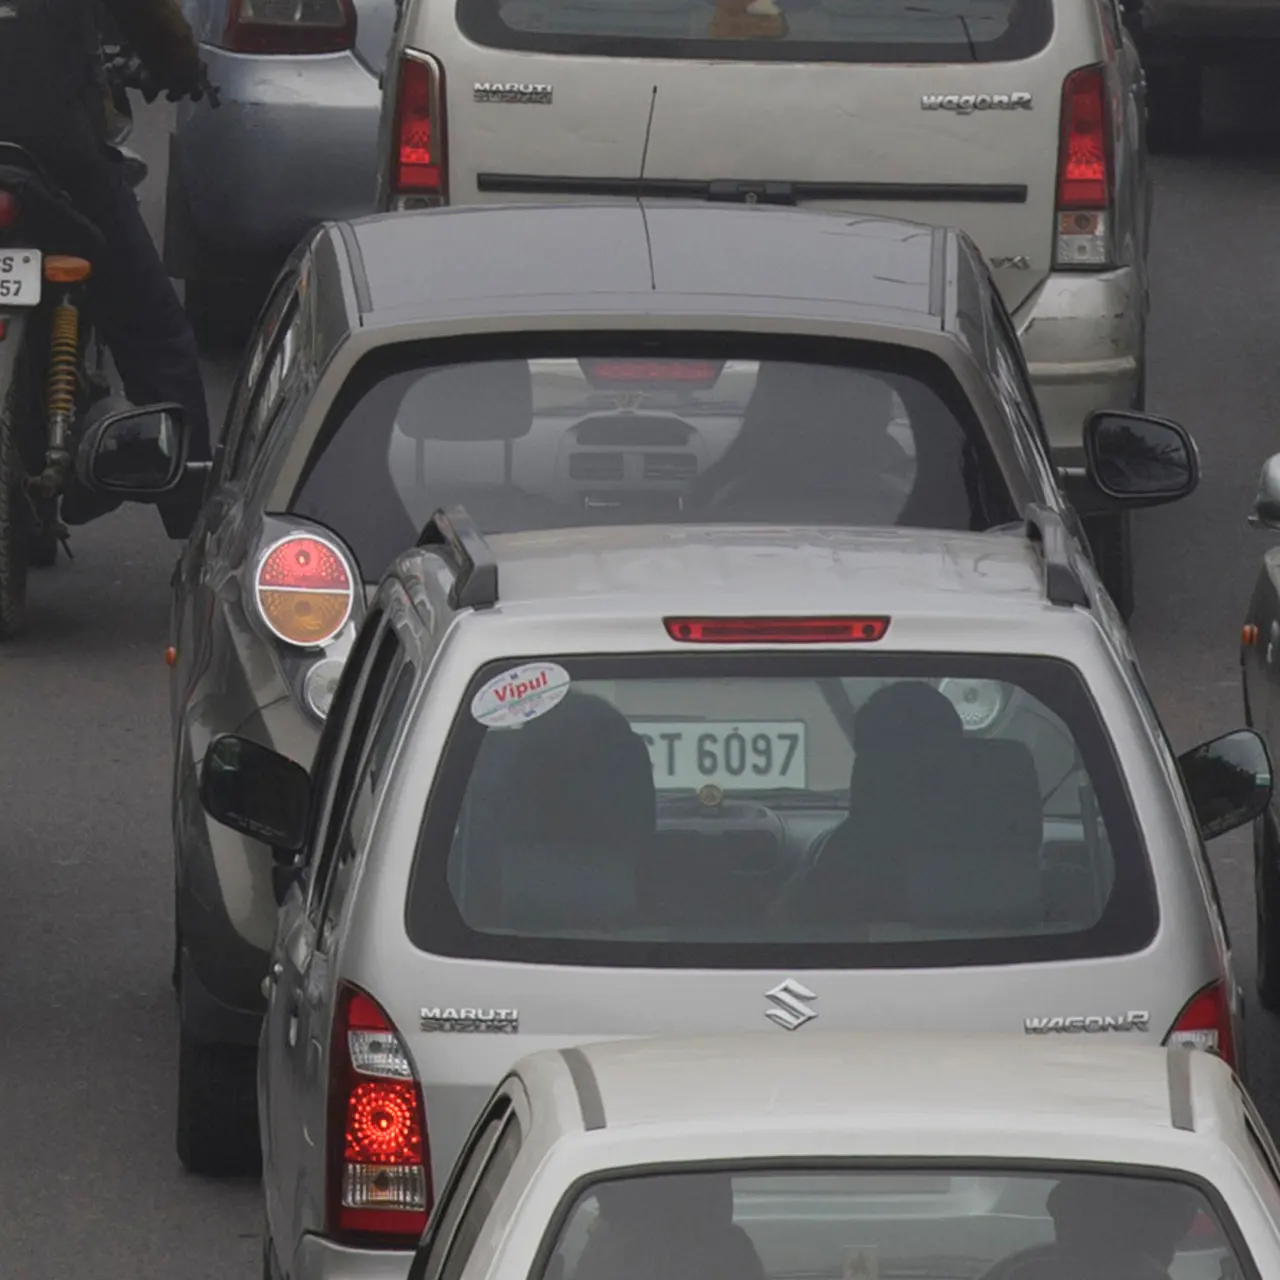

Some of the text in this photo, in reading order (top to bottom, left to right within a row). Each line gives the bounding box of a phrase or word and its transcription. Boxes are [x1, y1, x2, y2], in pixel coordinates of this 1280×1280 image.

[473, 83, 552, 93] MARUTI
[493, 670, 550, 704] Vipul
[696, 732, 799, 777] 6097
[420, 1007, 519, 1019] MARUTI
[420, 1018, 519, 1034] SUZUKI
